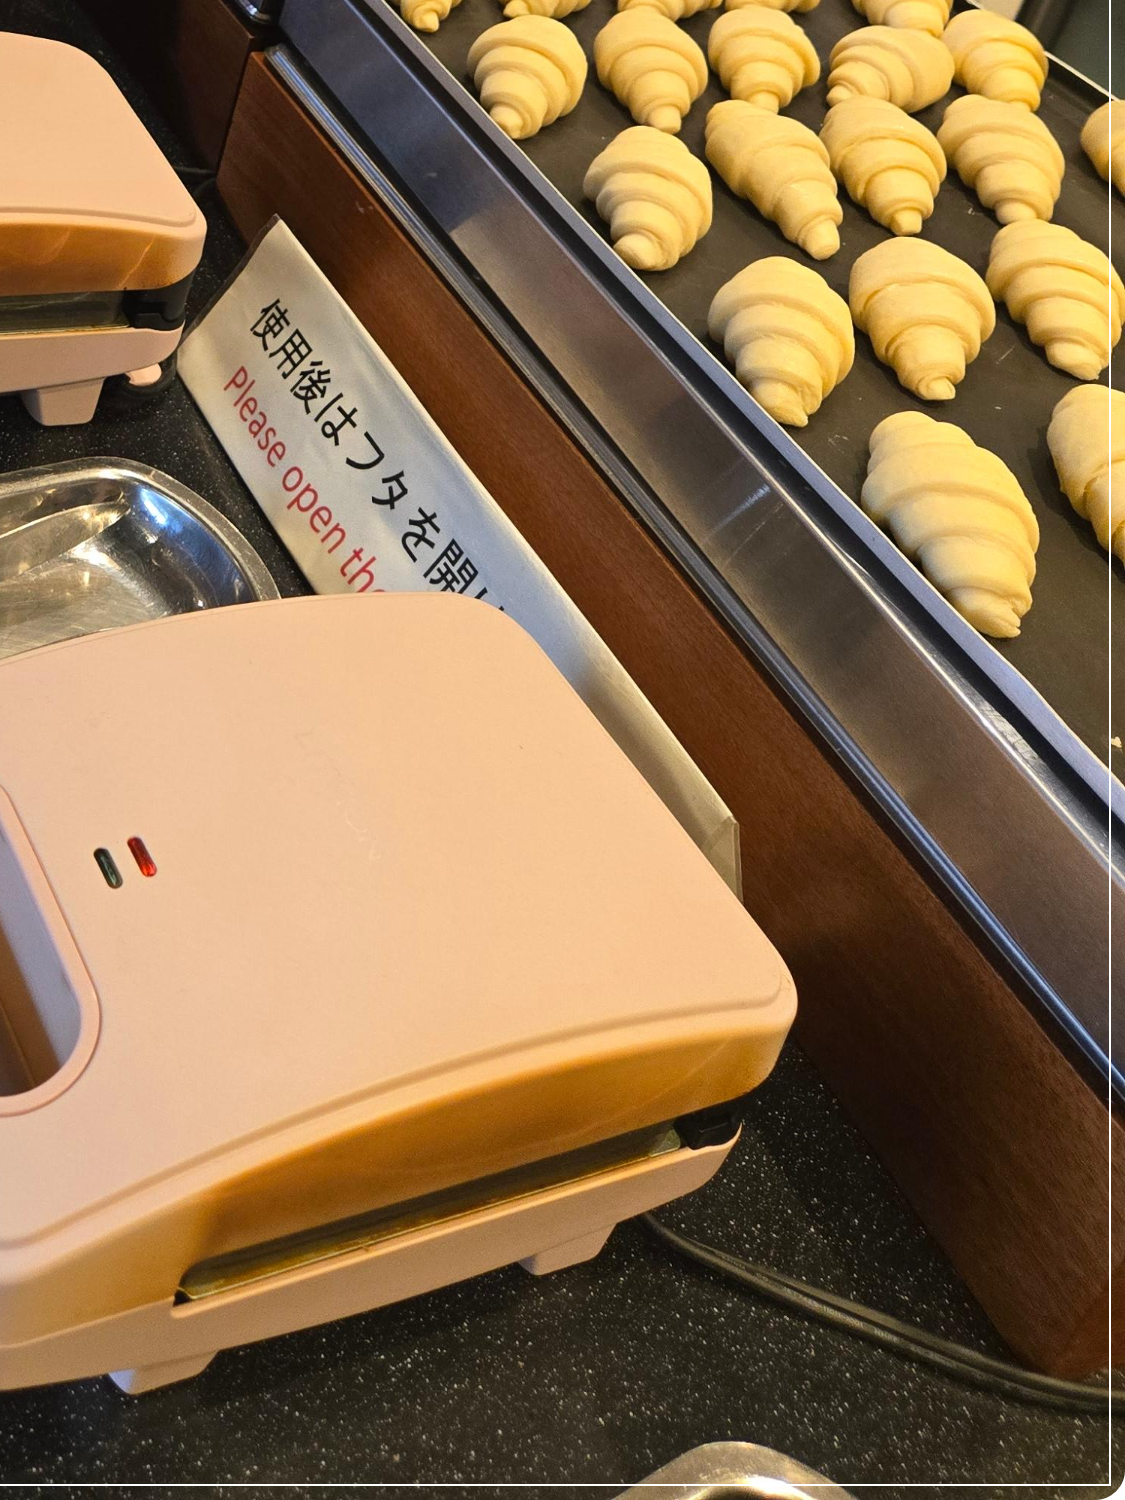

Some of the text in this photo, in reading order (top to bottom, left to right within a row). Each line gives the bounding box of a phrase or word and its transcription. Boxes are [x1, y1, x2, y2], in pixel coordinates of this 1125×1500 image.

[223, 365, 386, 593] Please open th
